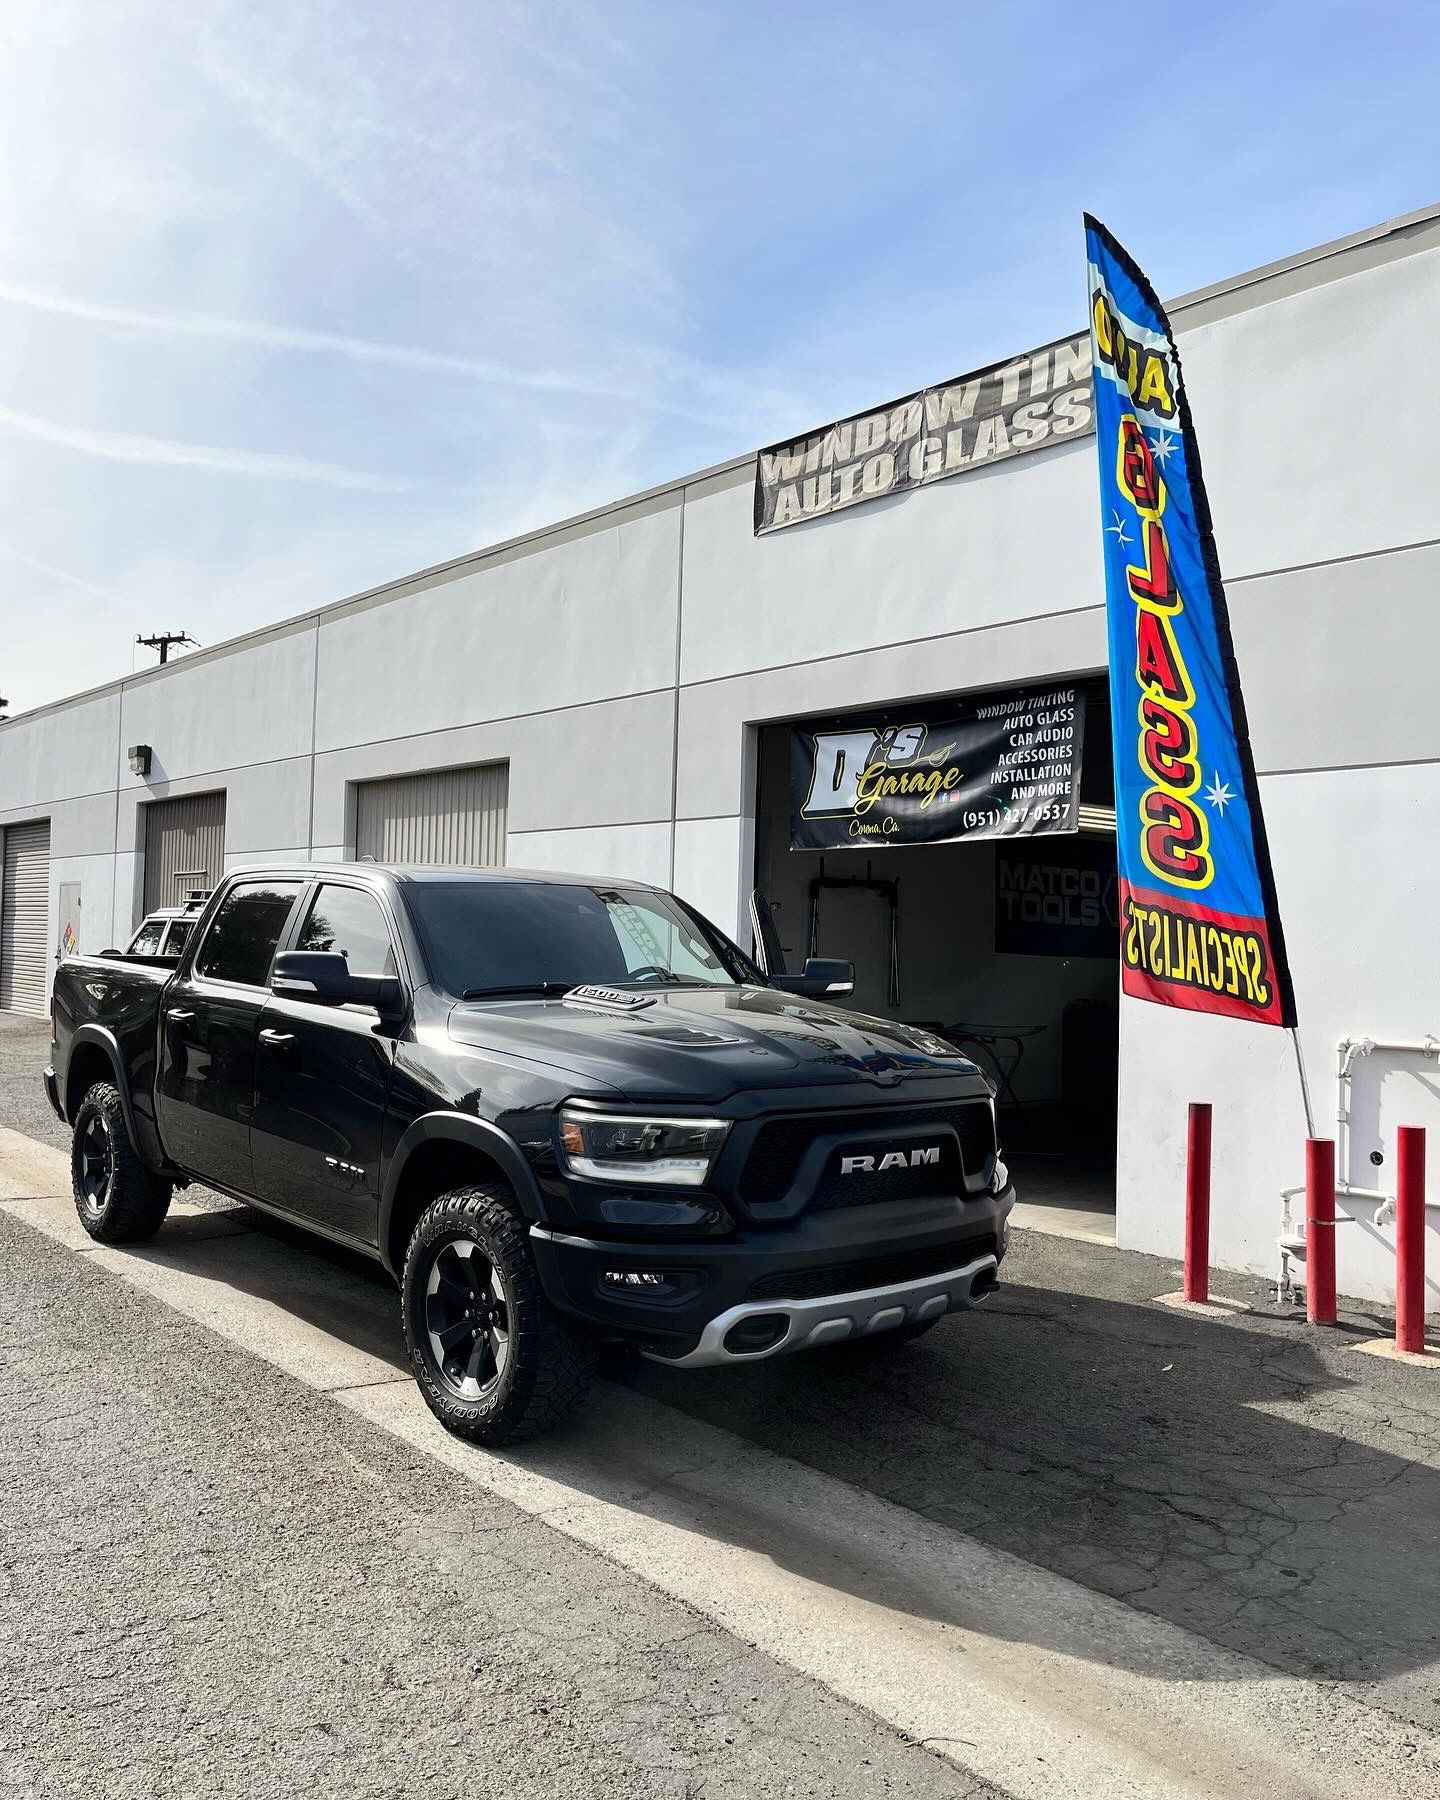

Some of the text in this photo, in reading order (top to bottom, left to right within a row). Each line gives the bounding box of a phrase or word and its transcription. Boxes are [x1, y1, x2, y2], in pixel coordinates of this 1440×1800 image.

[761, 378, 981, 487] WINDOW
[773, 388, 1092, 524] AUTO GLASS
[976, 689, 1075, 720] WINDOW TINTING
[1003, 708, 1075, 731] AUTO GLASS
[1009, 726, 1074, 747] CAR AUDIO
[998, 744, 1073, 767] ACCESSORIES
[990, 763, 1072, 785] INSTALLATION
[854, 762, 964, 815] Garage
[1011, 781, 1071, 800] AND MORE
[963, 803, 1071, 829] (951) 427-0537
[1000, 860, 1100, 898] MATCO
[1000, 889, 1100, 927] TOOLS
[840, 1147, 940, 1174] RAM
